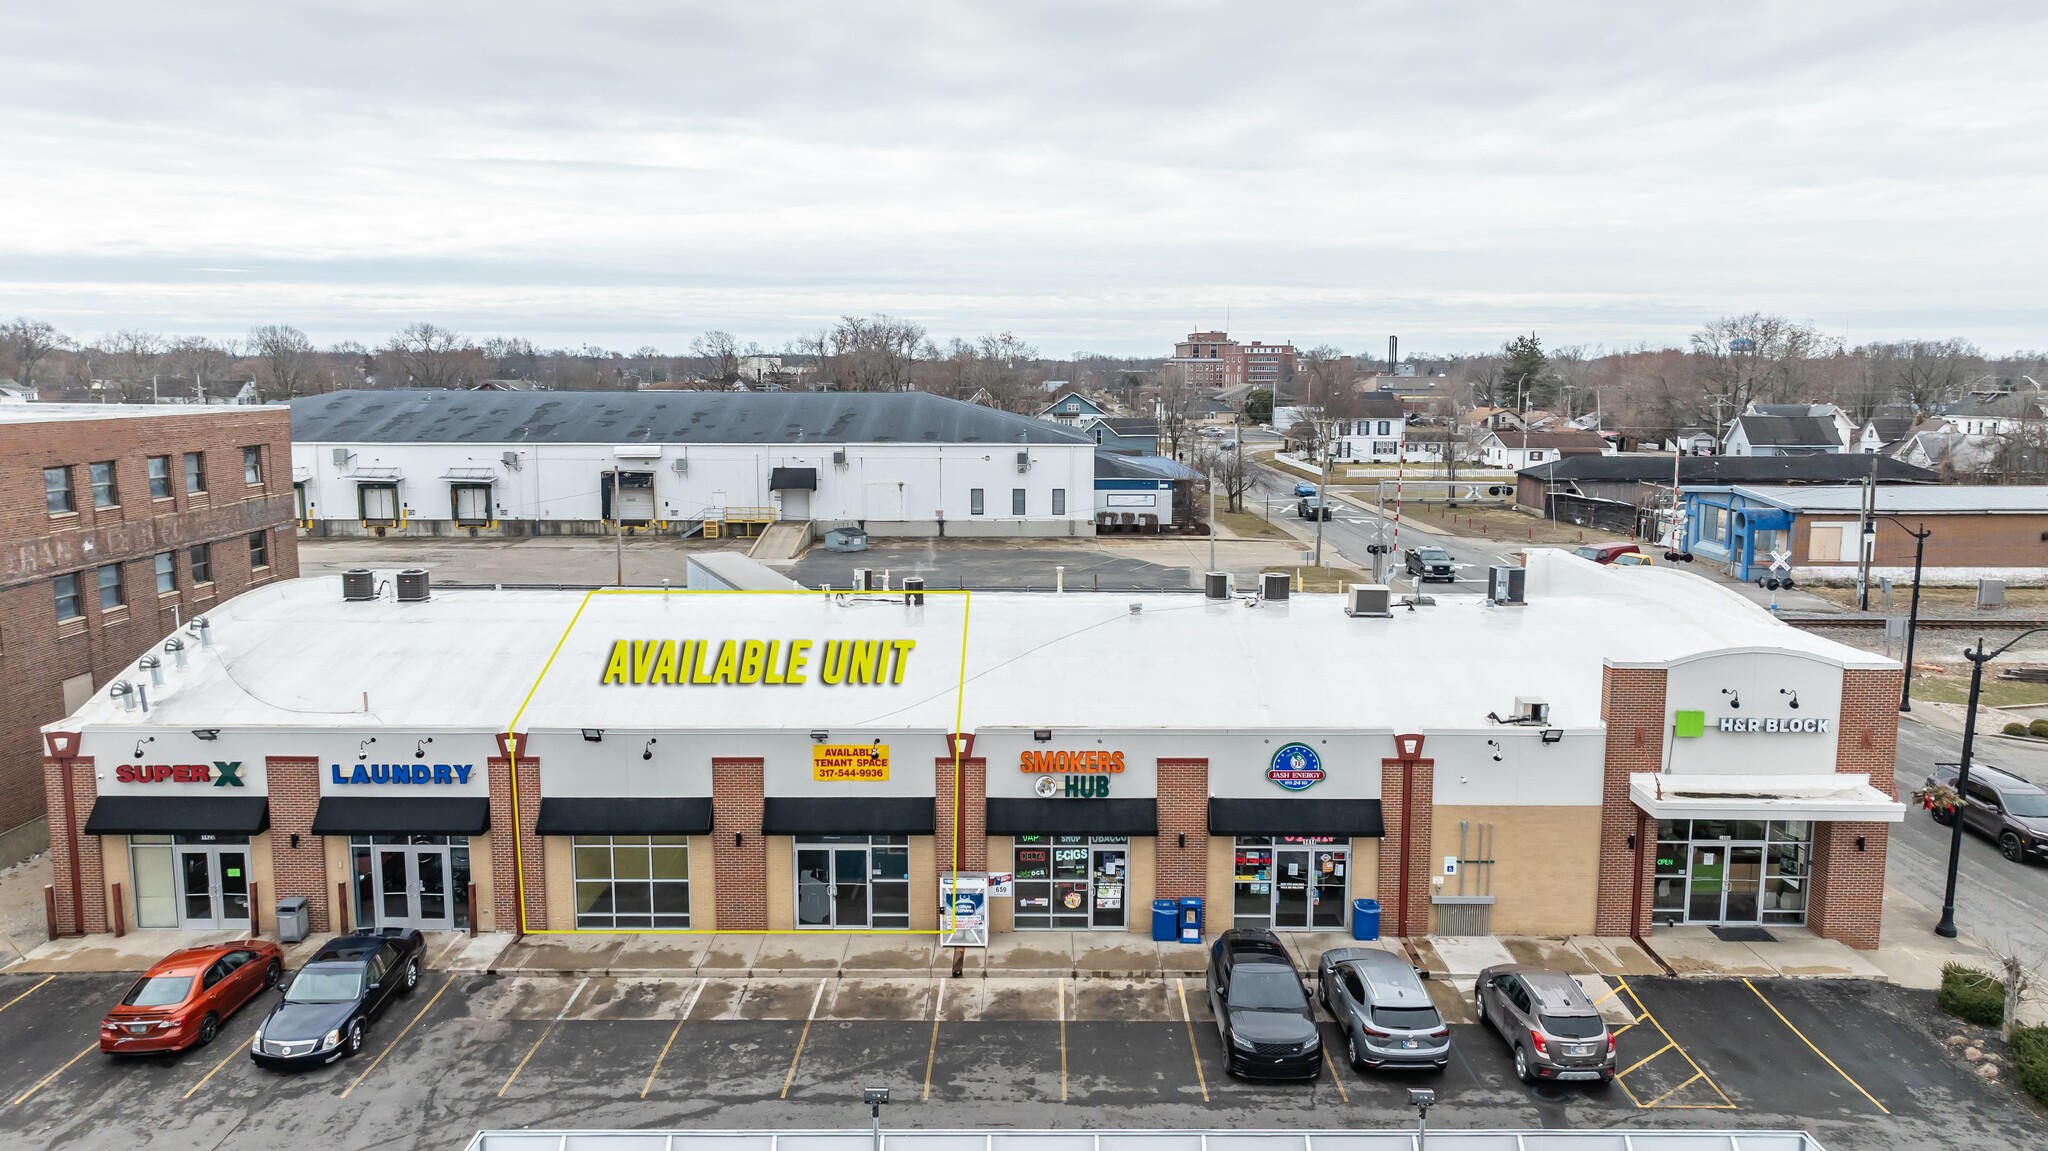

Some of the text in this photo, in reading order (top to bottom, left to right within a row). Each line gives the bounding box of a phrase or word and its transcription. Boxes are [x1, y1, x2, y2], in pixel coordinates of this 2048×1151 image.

[1719, 717, 1830, 733] H&R BLOCK
[825, 748, 879, 757] AVAILABL
[815, 758, 888, 767] TENANT SPACE
[1020, 750, 1125, 774] SMOKERS
[115, 761, 245, 787] SUPER X
[331, 764, 473, 785] LAUNDRY
[819, 769, 883, 778] 317-544-9936
[1064, 775, 1109, 799] HUB
[1656, 858, 1674, 866] OPEN
